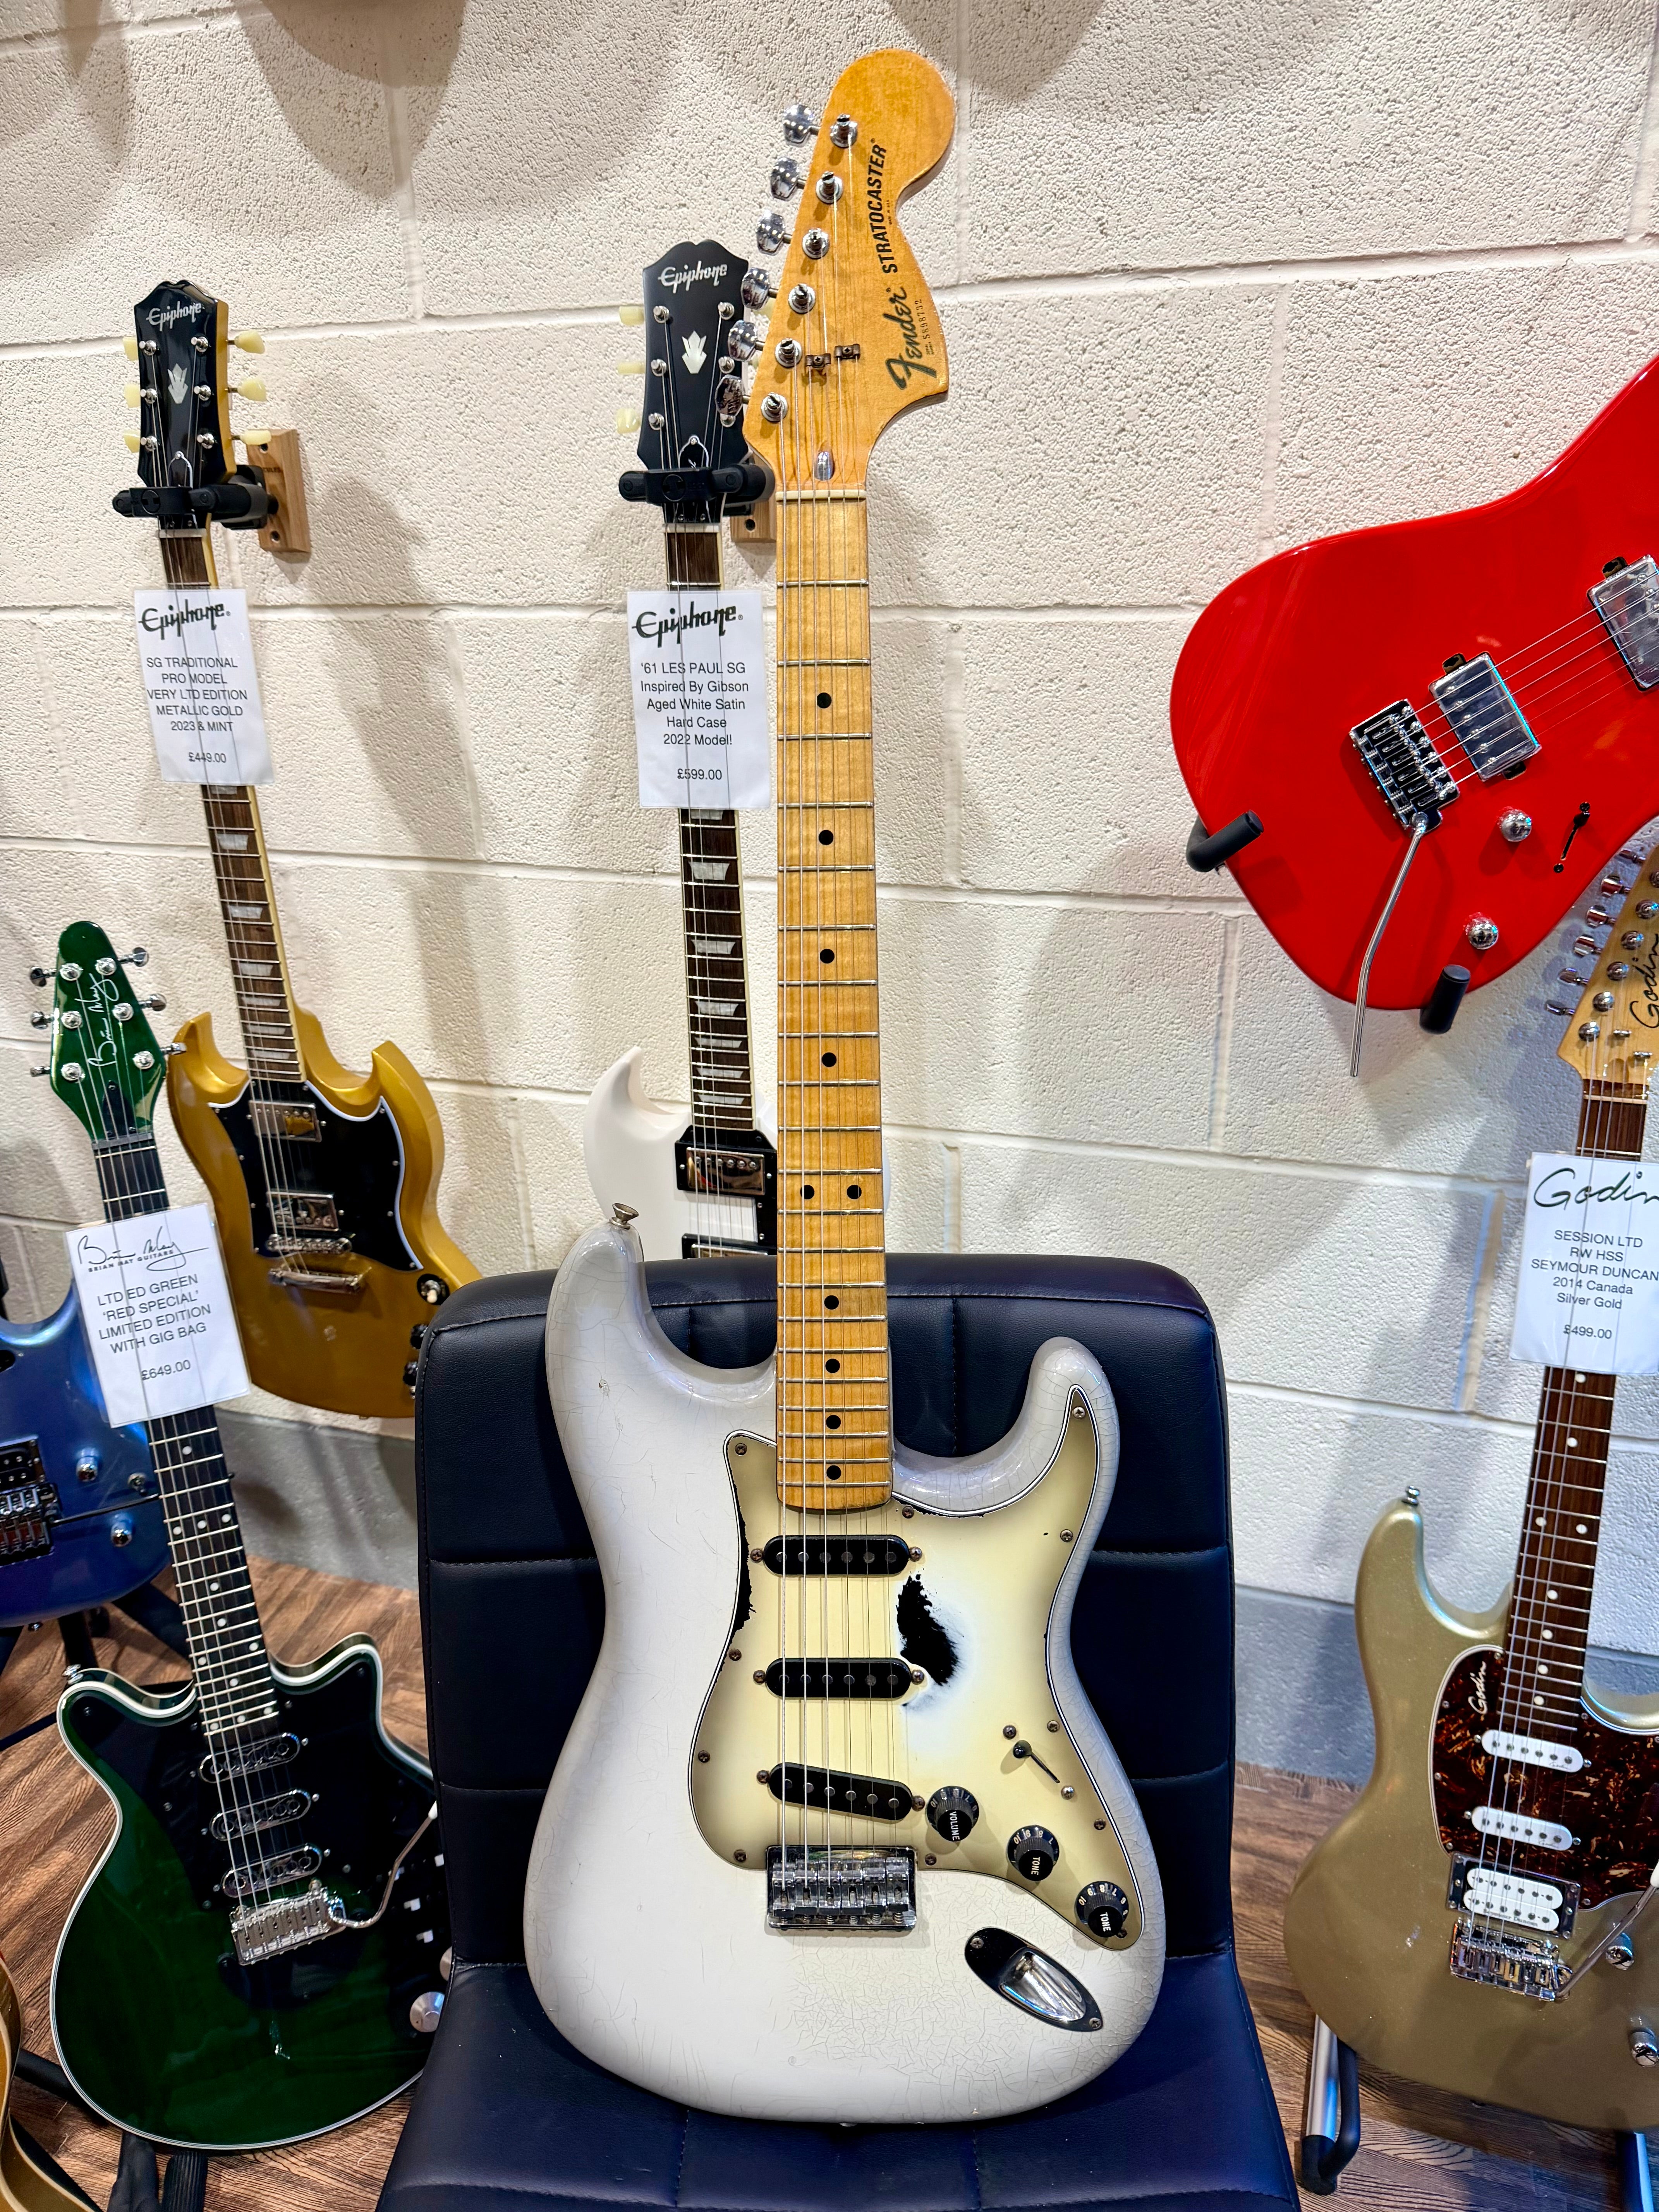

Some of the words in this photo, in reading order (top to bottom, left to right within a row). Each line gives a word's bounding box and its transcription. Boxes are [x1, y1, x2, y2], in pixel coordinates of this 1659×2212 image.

[867, 144, 897, 274] STRATOCASTER
[658, 261, 727, 294] Epiphone
[146, 301, 201, 331] Epiphone
[915, 299, 930, 339] S898732
[883, 287, 937, 390] Fender
[138, 599, 225, 640] Epiphone
[632, 601, 736, 647] Epiphone
[147, 657, 162, 668] SG
[165, 657, 238, 668] TRADITIONAL
[662, 663, 685, 673] LES
[690, 663, 723, 674] PAUL
[727, 662, 745, 673] SG
[162, 674, 186, 684] PRO
[189, 673, 227, 684] MODEL
[147, 689, 176, 699] VERY
[180, 690, 200, 699] LTD
[203, 690, 247, 700] EDITION
[641, 681, 685, 695] Inspired
[689, 681, 703, 694] By
[708, 680, 749, 692] Gibson
[156, 705, 209, 716] METALLIC
[211, 706, 243, 716] GOLD
[647, 699, 676, 712] Aged
[680, 699, 711, 709] White
[715, 699, 745, 710] Satin
[171, 721, 195, 731] 2023
[198, 721, 205, 731] &
[208, 721, 234, 732] MINT
[667, 717, 693, 728] Hard
[697, 717, 727, 728] Case
[664, 734, 690, 745] 2022
[694, 734, 732, 745] Model!
[189, 752, 227, 763] £449.00
[677, 769, 722, 780] £599.00
[1630, 933, 1659, 1028] Godin
[1534, 1168, 1659, 1211] Godin
[1554, 1230, 1613, 1245] SESSION
[1618, 1237, 1643, 1248] LTD
[88, 1263, 115, 1273] BRIAN
[137, 1250, 173, 1262] GUITARS
[1570, 1247, 1592, 1258] RW
[1596, 1250, 1623, 1262] HSS
[1531, 1259, 1598, 1275] SEYMOUR
[1602, 1266, 1659, 1281] DUNCAN
[97, 1291, 124, 1306] LTD
[127, 1286, 146, 1300] ED
[150, 1274, 198, 1294] GREEN
[1553, 1277, 1583, 1288] 2014
[1586, 1281, 1633, 1294] Canada
[1557, 1293, 1590, 1305] Silver
[1594, 1297, 1622, 1309] Gold
[99, 1319, 153, 1340] LIMITED
[156, 1304, 211, 1326] EDITION
[110, 1338, 146, 1354] WITH
[149, 1330, 174, 1345] GIG
[179, 1322, 206, 1338] BAG
[1563, 1324, 1612, 1339] £499.00
[142, 1359, 191, 1380] £649.00
[1468, 1661, 1488, 1715] Godin
[930, 1798, 938, 1808] 10
[950, 1811, 960, 1841] VOLUME
[1013, 1834, 1022, 1844] 10
[1031, 1856, 1041, 1875] TONE
[1099, 1884, 1105, 1893] 8
[1079, 1896, 1086, 1905] 10
[1100, 1912, 1111, 1932] TONE
